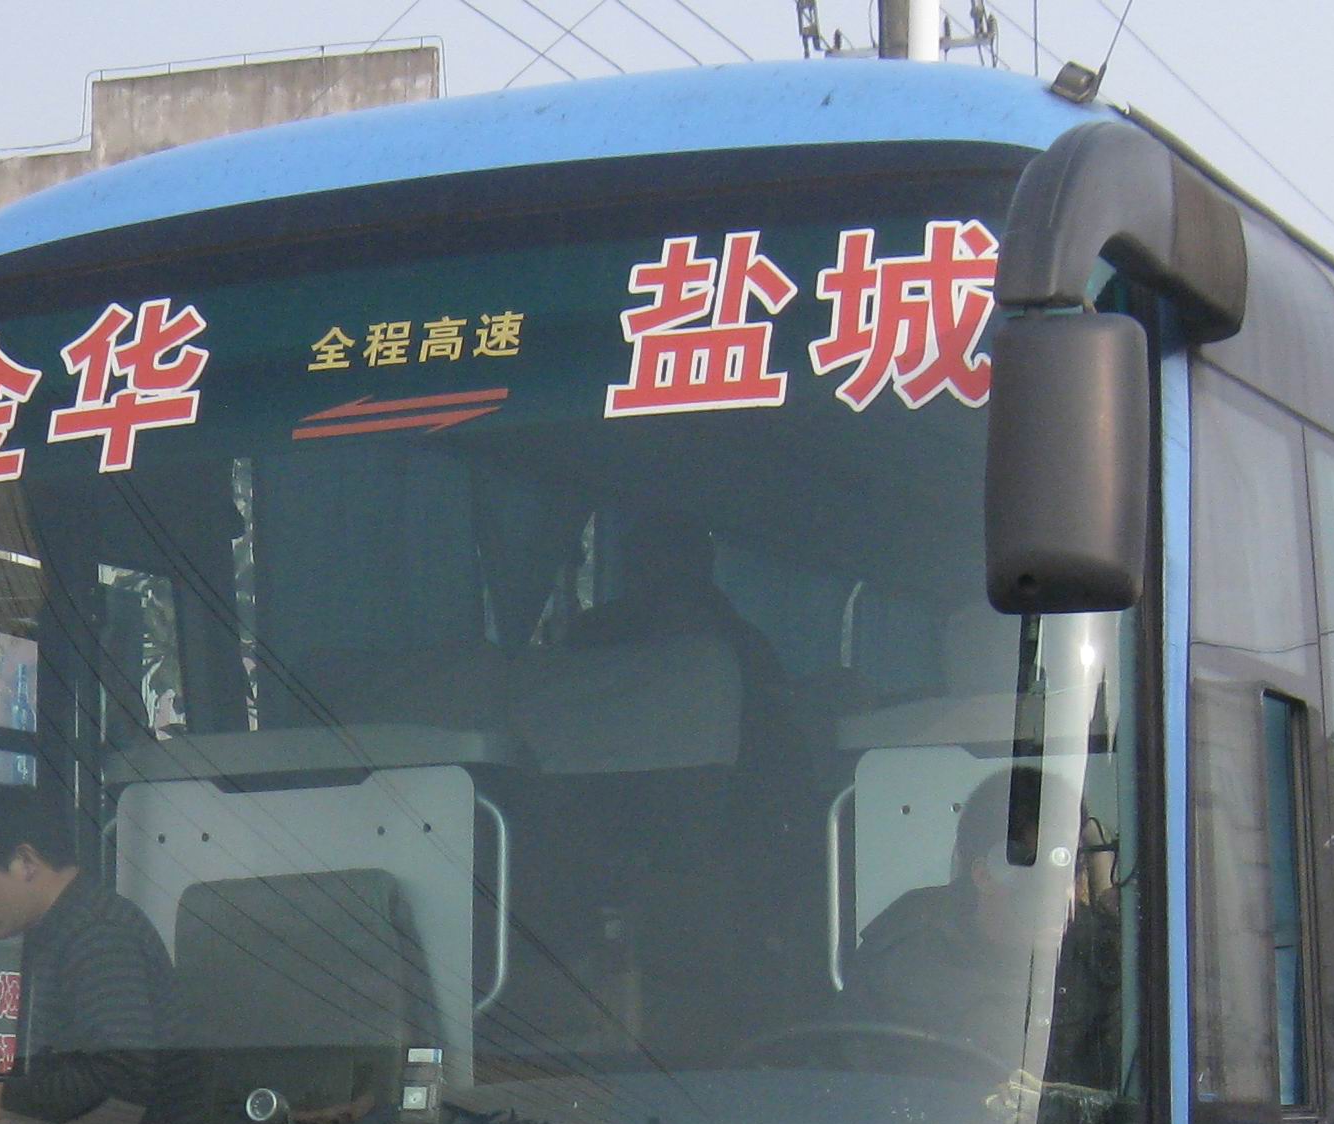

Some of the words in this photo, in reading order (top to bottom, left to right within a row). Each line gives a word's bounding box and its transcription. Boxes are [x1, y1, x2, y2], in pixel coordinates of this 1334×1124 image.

[308, 311, 524, 372] 全程高速
[603, 219, 998, 419] 盐城
